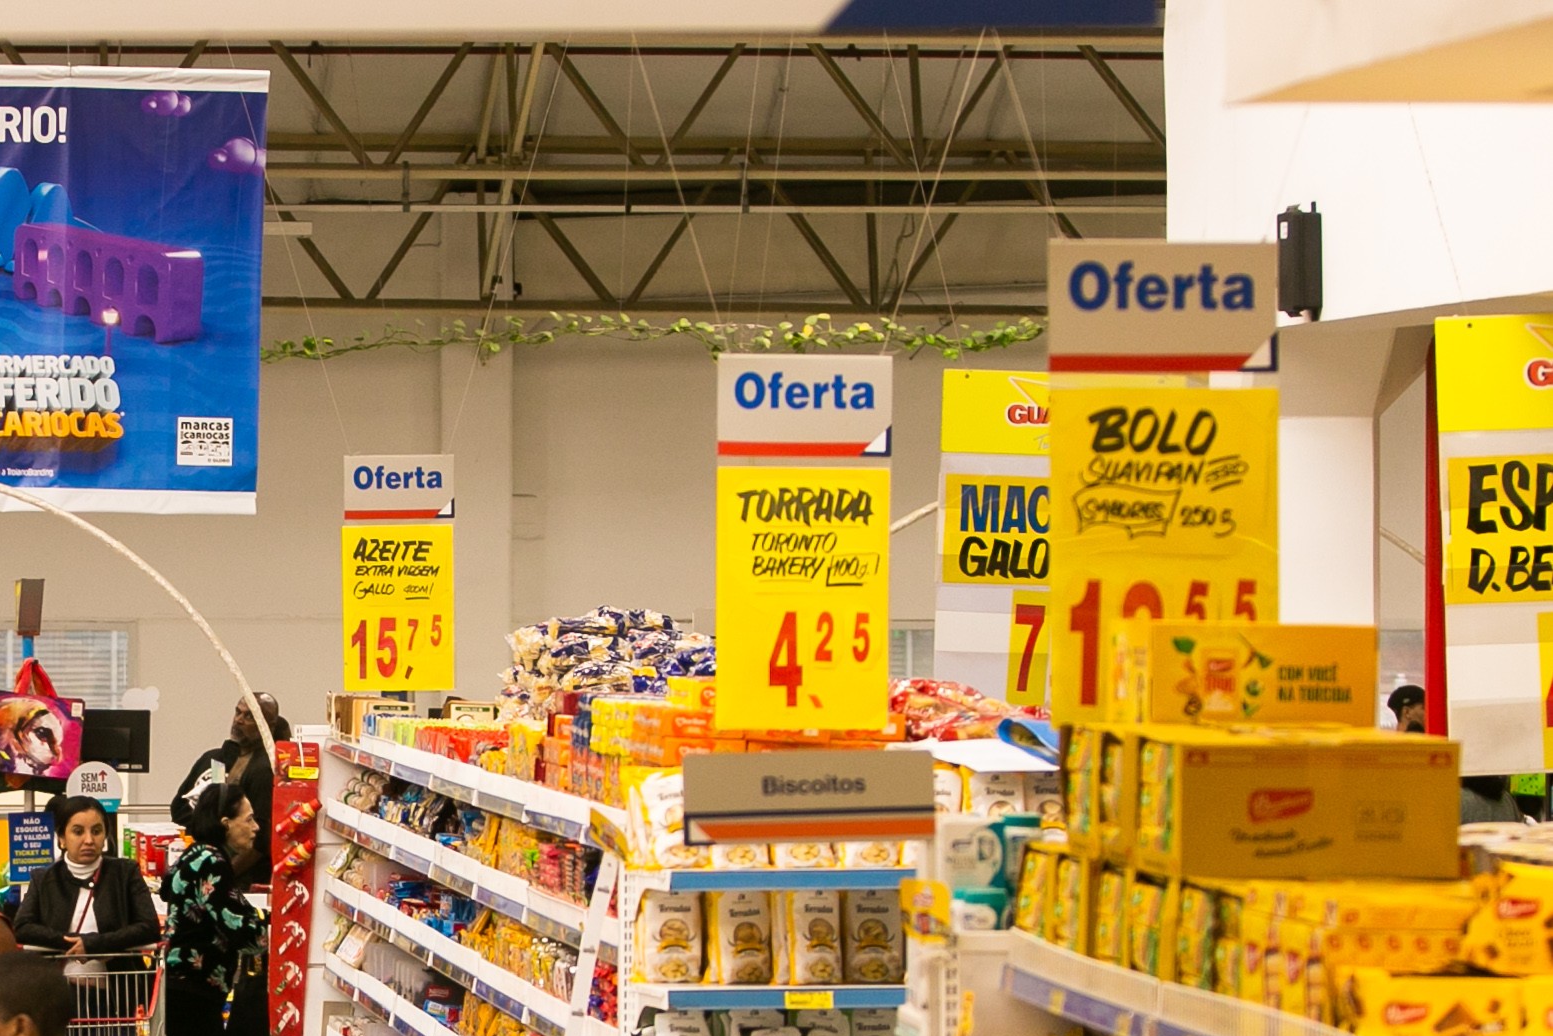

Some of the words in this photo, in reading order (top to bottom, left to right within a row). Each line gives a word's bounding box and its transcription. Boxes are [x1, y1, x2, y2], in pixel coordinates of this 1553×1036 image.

[1068, 260, 1256, 312] Oferta
[734, 370, 875, 410] Oferta
[1088, 406, 1218, 456] BOLO
[353, 465, 443, 490] Oferta
[737, 486, 874, 527] TORRADA
[353, 537, 433, 563] AZEITE
[751, 531, 837, 554] TORONTO
[355, 565, 393, 577] EXTRA
[752, 556, 825, 580] BAKERY
[354, 580, 395, 599] GALLO
[80, 773, 98, 783] SEM
[80, 783, 108, 793] PARAR
[762, 775, 866, 796] Biscoitos
[23, 817, 40, 825] NÃO
